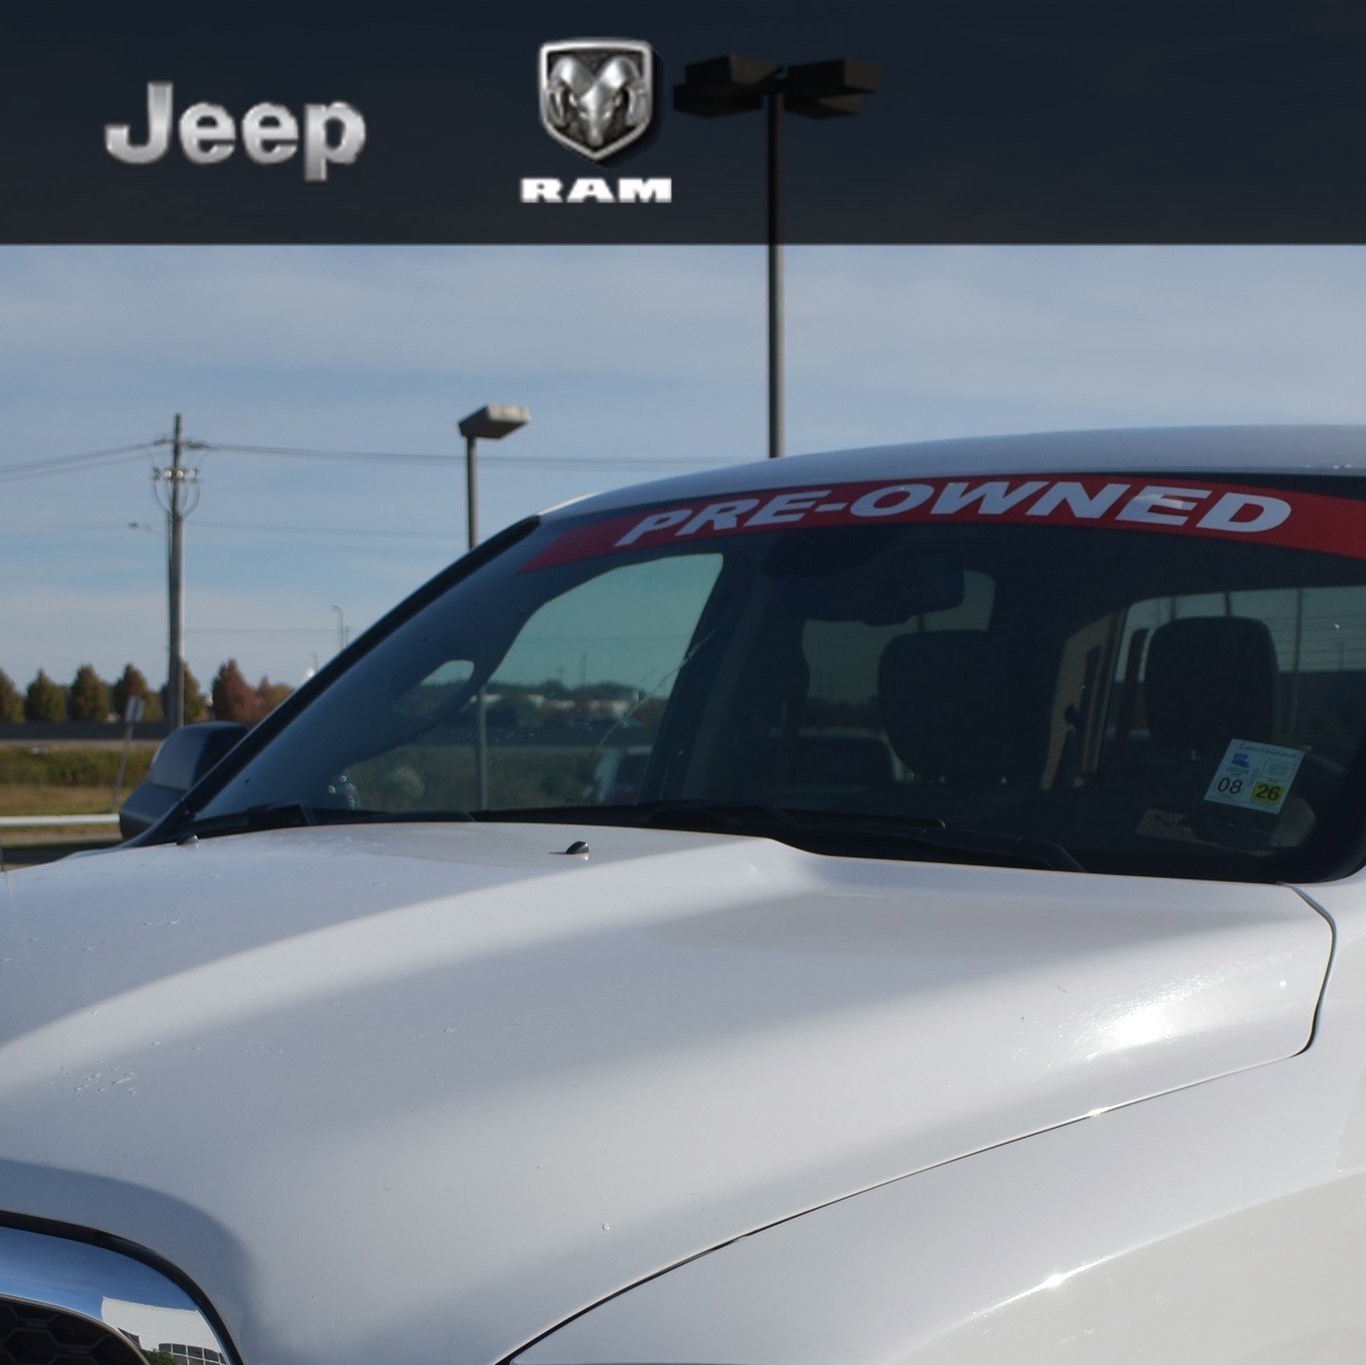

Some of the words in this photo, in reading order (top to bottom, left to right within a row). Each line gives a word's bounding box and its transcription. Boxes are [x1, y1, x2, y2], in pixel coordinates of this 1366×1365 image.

[614, 480, 1293, 546] PRE-OWNED
[1217, 777, 1243, 795] 08
[1255, 783, 1282, 801] 26
